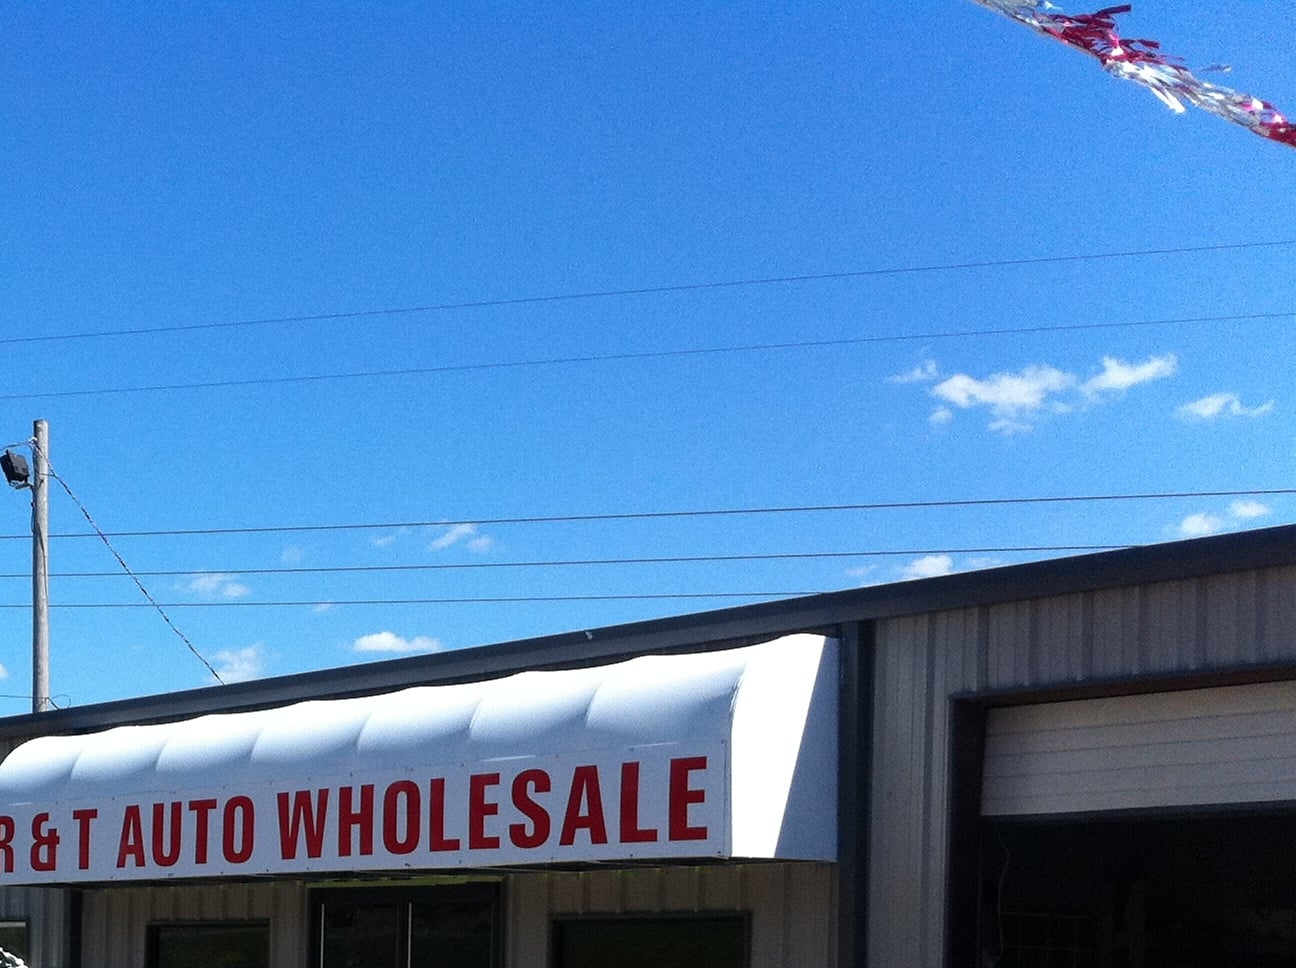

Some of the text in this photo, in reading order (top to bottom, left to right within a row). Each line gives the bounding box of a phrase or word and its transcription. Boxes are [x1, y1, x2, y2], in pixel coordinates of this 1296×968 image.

[31, 812, 60, 872] &
[73, 808, 98, 870] T
[117, 795, 255, 868] AUTO
[277, 756, 708, 860] WHOLESALE
